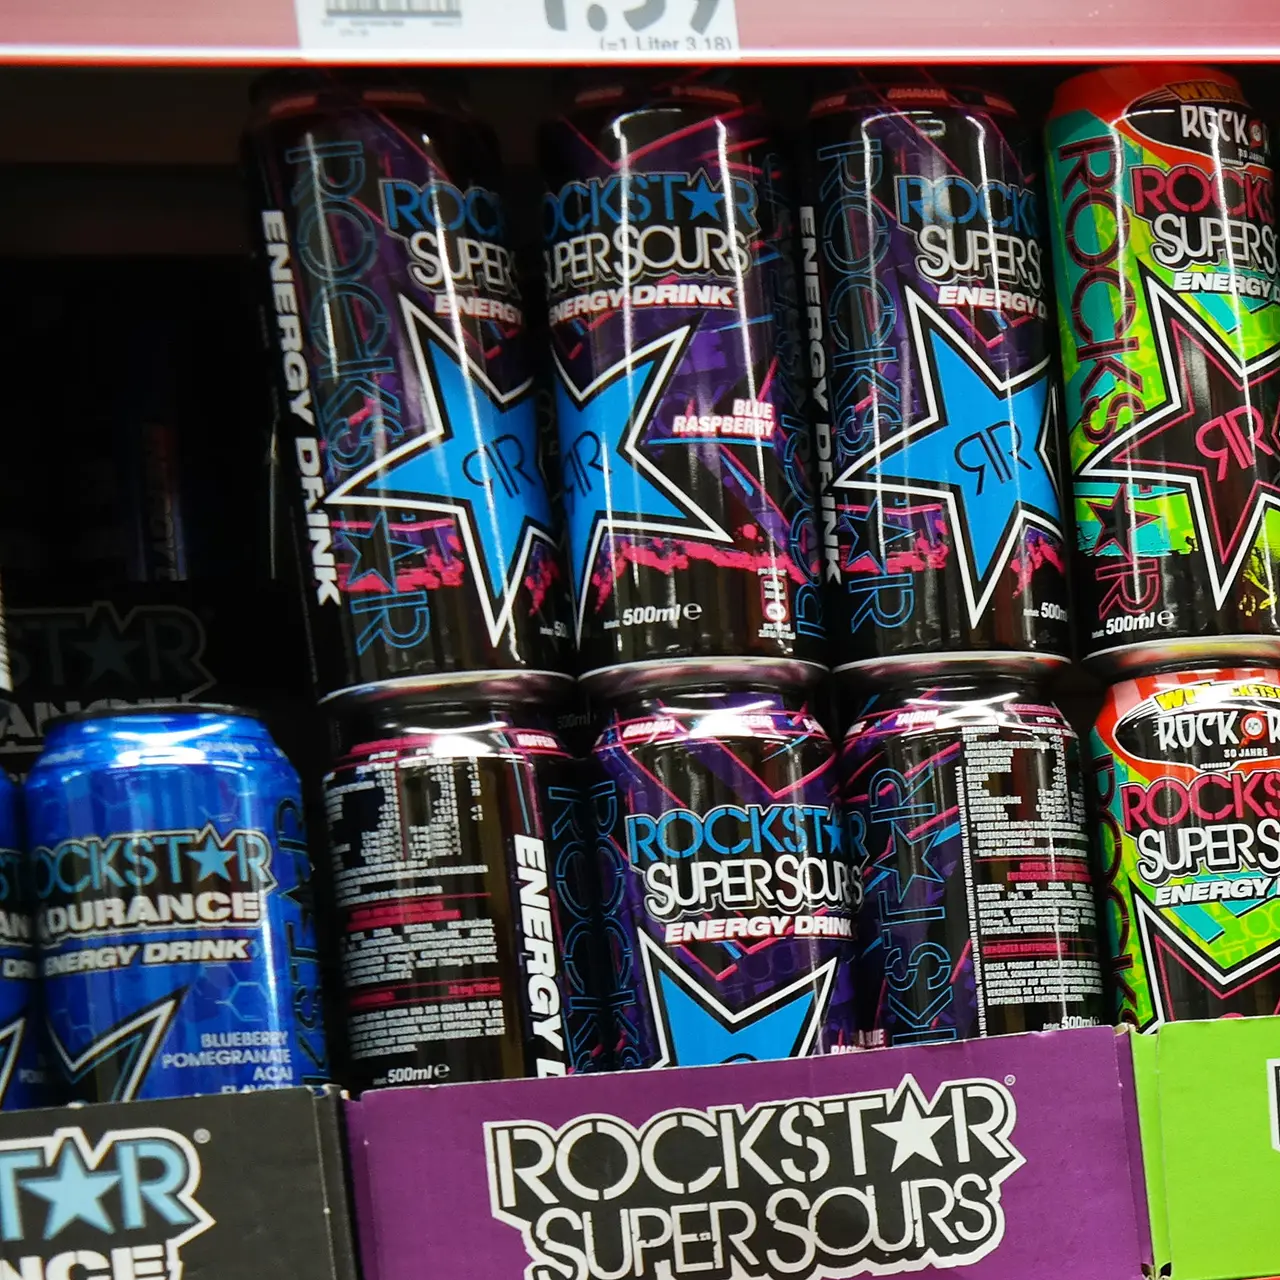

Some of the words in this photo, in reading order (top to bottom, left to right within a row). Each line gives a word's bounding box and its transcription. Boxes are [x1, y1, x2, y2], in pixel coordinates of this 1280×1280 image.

[632, 283, 734, 308] DRINK
[260, 209, 311, 426] ENERGY
[292, 429, 343, 608] DRINK
[732, 399, 774, 420] BLUE
[673, 414, 775, 438] RASPBERRY
[513, 833, 566, 1048] ENERGY
[665, 921, 791, 944] ENERGY
[795, 918, 853, 939] DRINK
[142, 940, 250, 965] DRINK
[201, 1033, 288, 1048] BLUEBERRY
[162, 1049, 292, 1069] POMEGRANATE
